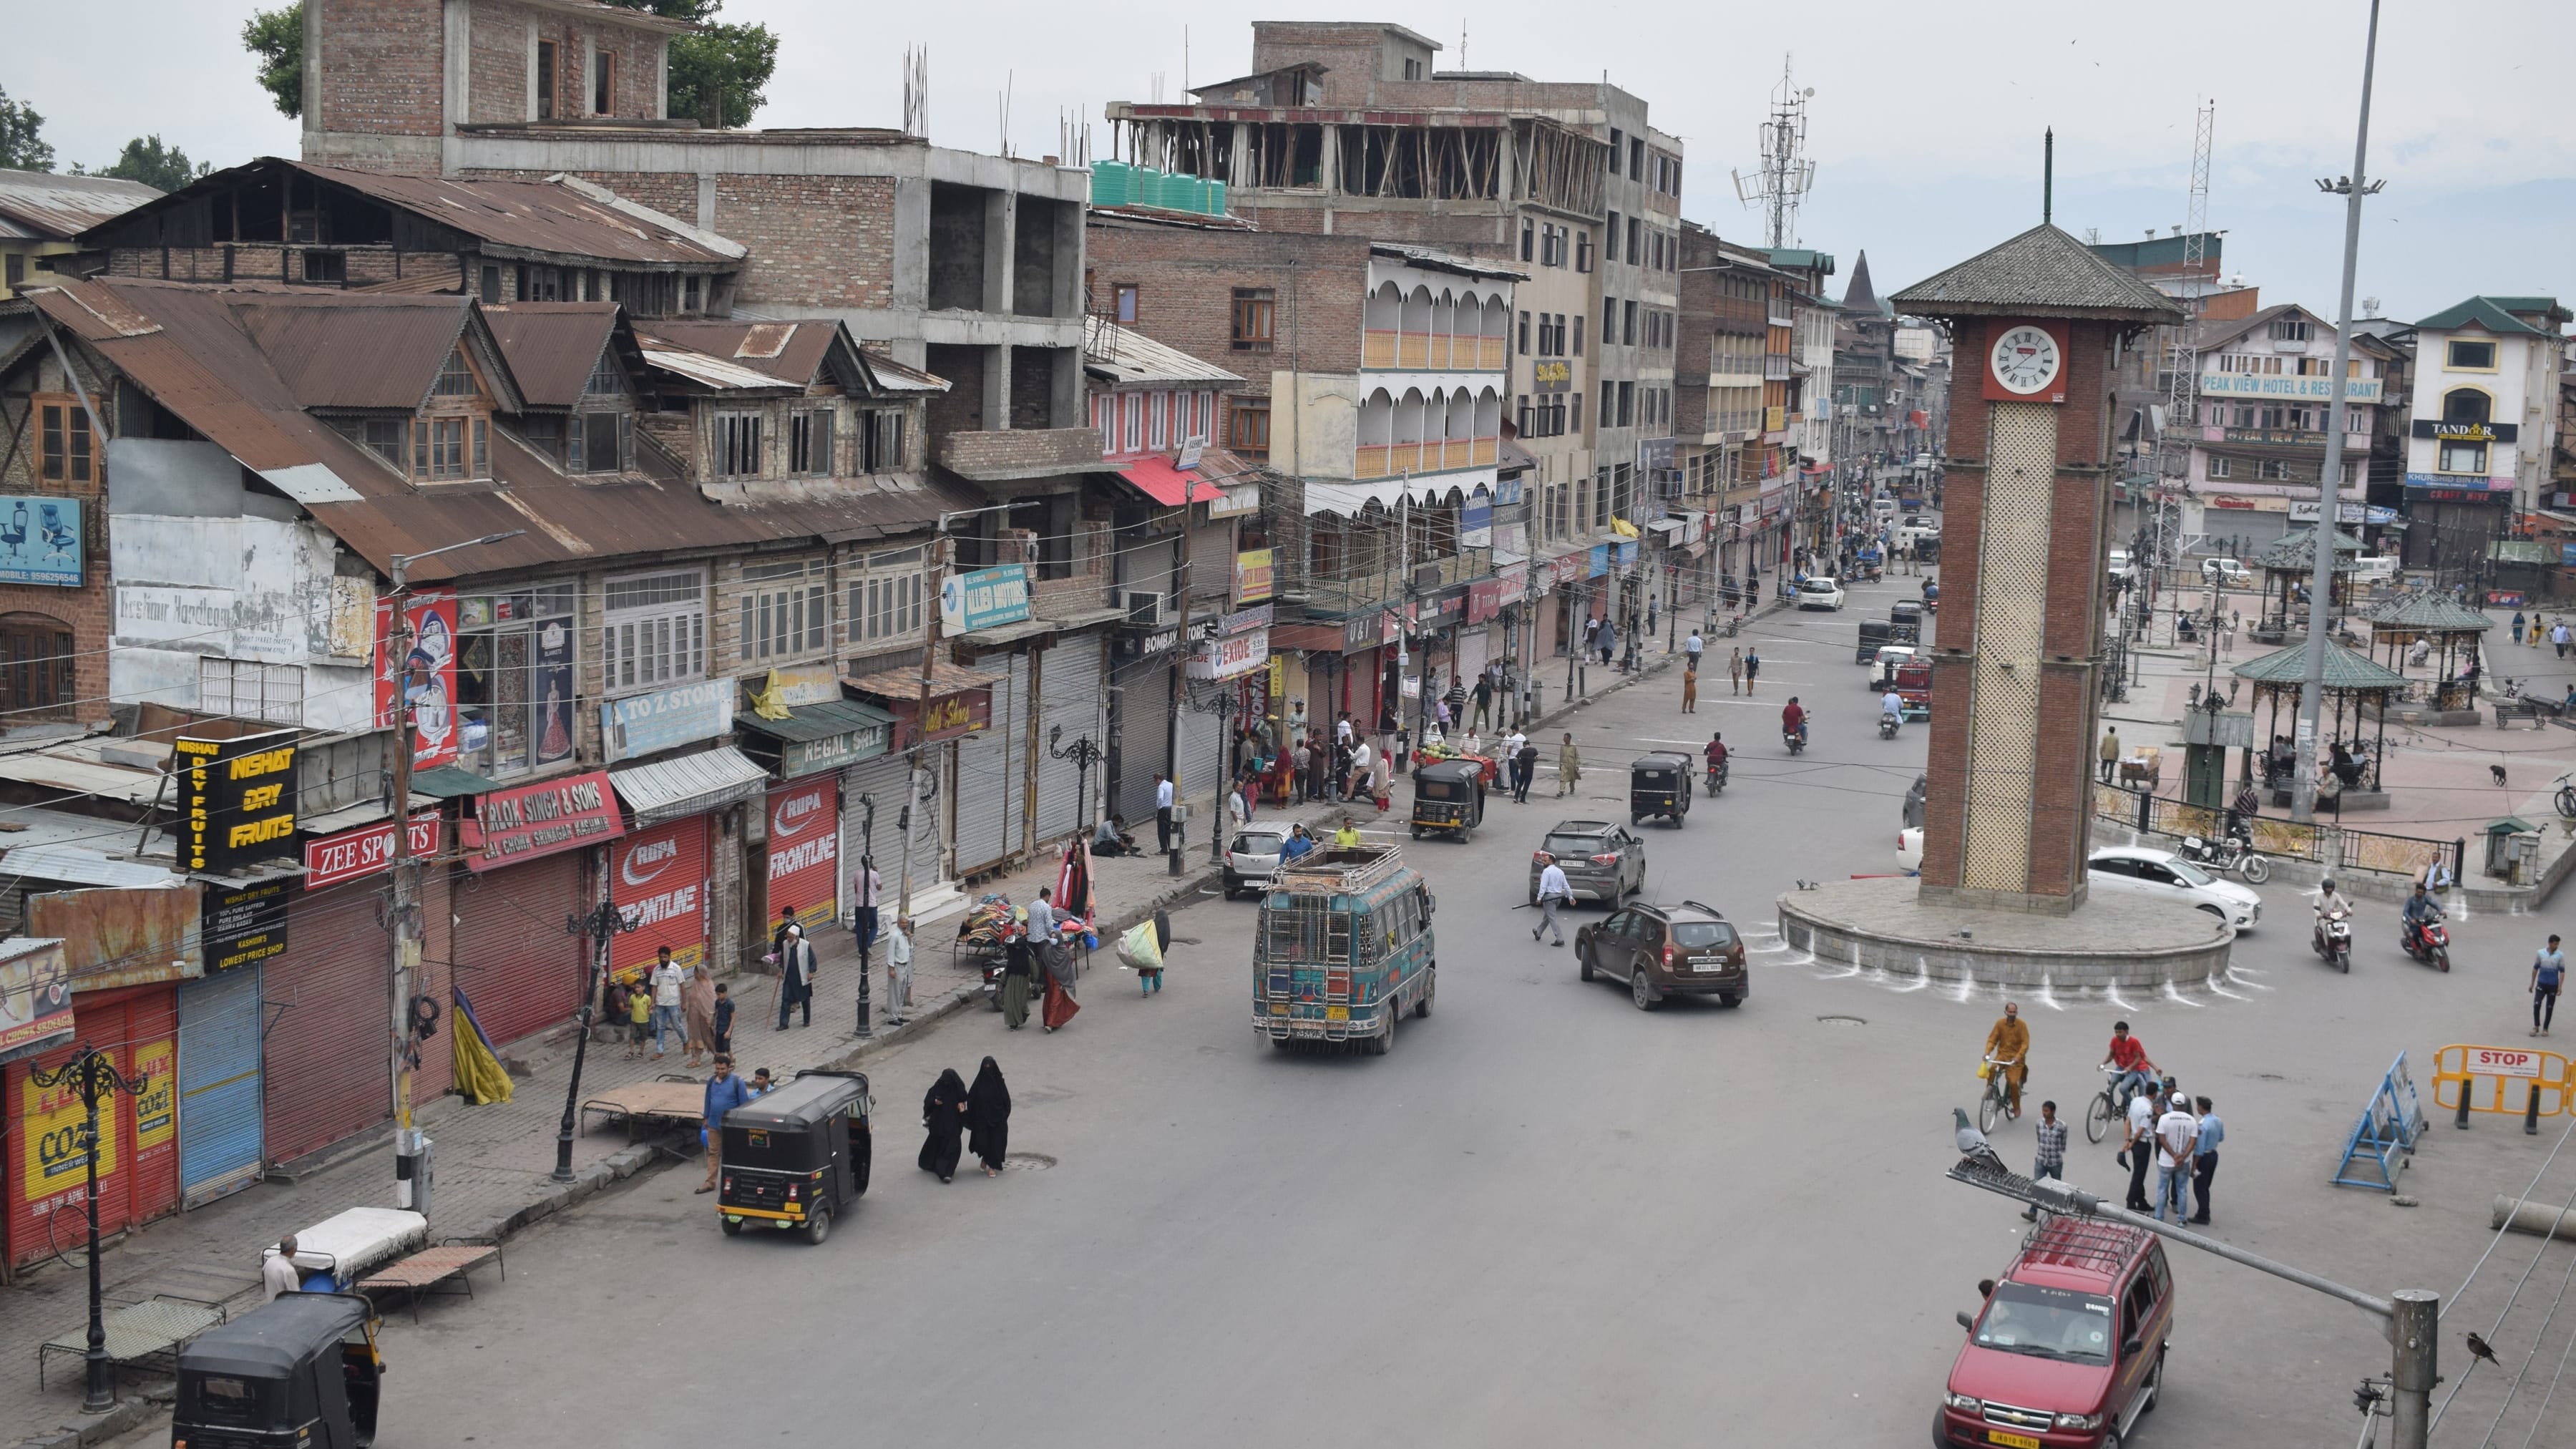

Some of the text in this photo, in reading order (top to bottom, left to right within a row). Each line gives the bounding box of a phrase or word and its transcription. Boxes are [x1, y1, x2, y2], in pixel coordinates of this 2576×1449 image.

[2203, 376, 2379, 398] PEAK VIEW HOTEL & RESURANT
[2239, 431, 2293, 443] PEAK VIEW
[2408, 473, 2454, 483] KHURSHID
[2456, 475, 2471, 484] BIN
[2430, 490, 2491, 501] CRAFT HIVE
[1500, 508, 1518, 522] SONY
[31, 572, 79, 583] 9596256546
[967, 579, 1027, 615] ALLIED MOTORS
[1482, 594, 1496, 608] TITAN
[1145, 624, 1206, 654] BOMBAY TORE
[1350, 623, 1357, 642] U
[1357, 620, 1364, 641] &
[1223, 635, 1250, 665] EXIDE
[610, 706, 625, 726] A
[626, 701, 652, 720] TO
[654, 695, 667, 714] Z
[670, 681, 728, 711] STORE
[177, 740, 220, 756] NISHAT
[804, 733, 848, 763] REGAL
[853, 725, 883, 751] SALE
[230, 747, 296, 780] NISHAT
[243, 783, 283, 811] DRY
[475, 781, 603, 836] TRLOK SINGH & SONS
[787, 792, 822, 819] RUPA
[190, 756, 208, 869] DRY FRUITS
[229, 814, 294, 849] FRUITS
[502, 833, 532, 855] CHOWK
[533, 823, 573, 846] SRINAGAR
[573, 814, 612, 836] KASHMIR
[320, 823, 429, 876] ZEE SPOTS
[636, 839, 677, 866] RUPA
[769, 832, 836, 881] FRONTLINE
[225, 885, 280, 904] NISHAT DRY FRUITS
[232, 906, 245, 914] PURE
[245, 902, 265, 911] SAFFRON
[618, 884, 698, 935] FRONTLINE
[220, 942, 284, 968] LOWEST PRICE SHOP
[237, 934, 268, 949] KASHMIR'S
[6, 1025, 36, 1043] CHOWK
[2480, 1051, 2529, 1066] STOP
[39, 1083, 87, 1116] LU
